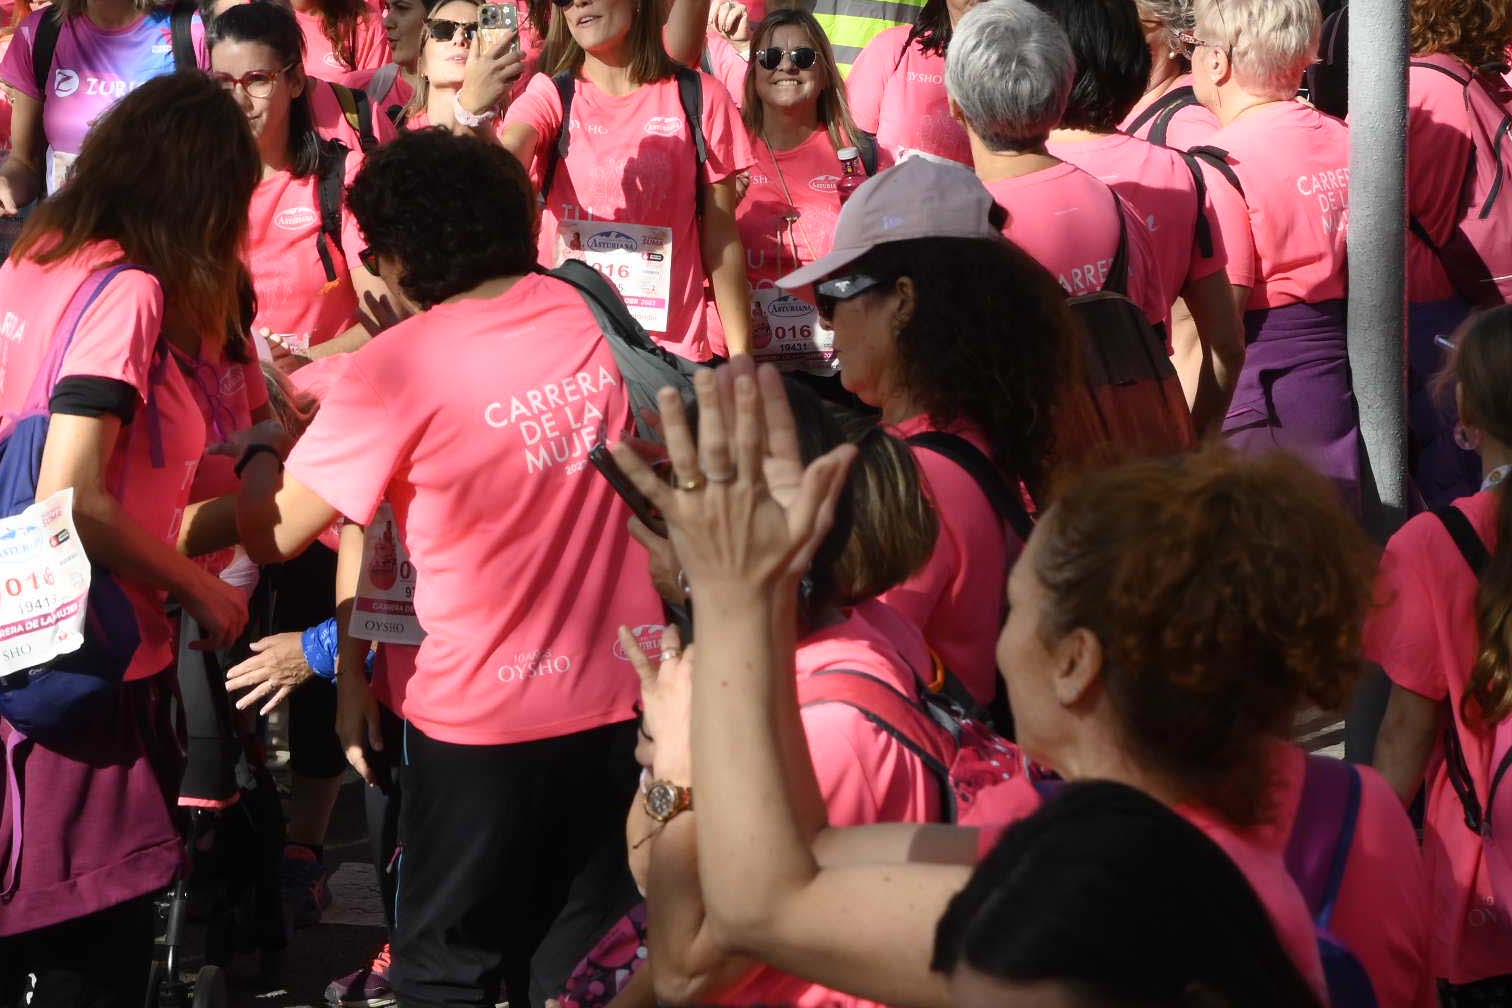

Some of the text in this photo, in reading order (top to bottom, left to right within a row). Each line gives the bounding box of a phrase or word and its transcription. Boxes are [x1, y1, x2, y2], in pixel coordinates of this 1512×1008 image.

[591, 238, 636, 252] ASTURIANA
[775, 325, 812, 339] 016
[484, 365, 617, 428] CARRERA
[519, 400, 604, 446] DE LA
[524, 426, 606, 474] MUJE
[24, 620, 39, 632] DE
[40, 614, 54, 627] LA
[365, 621, 405, 633] OYSHO
